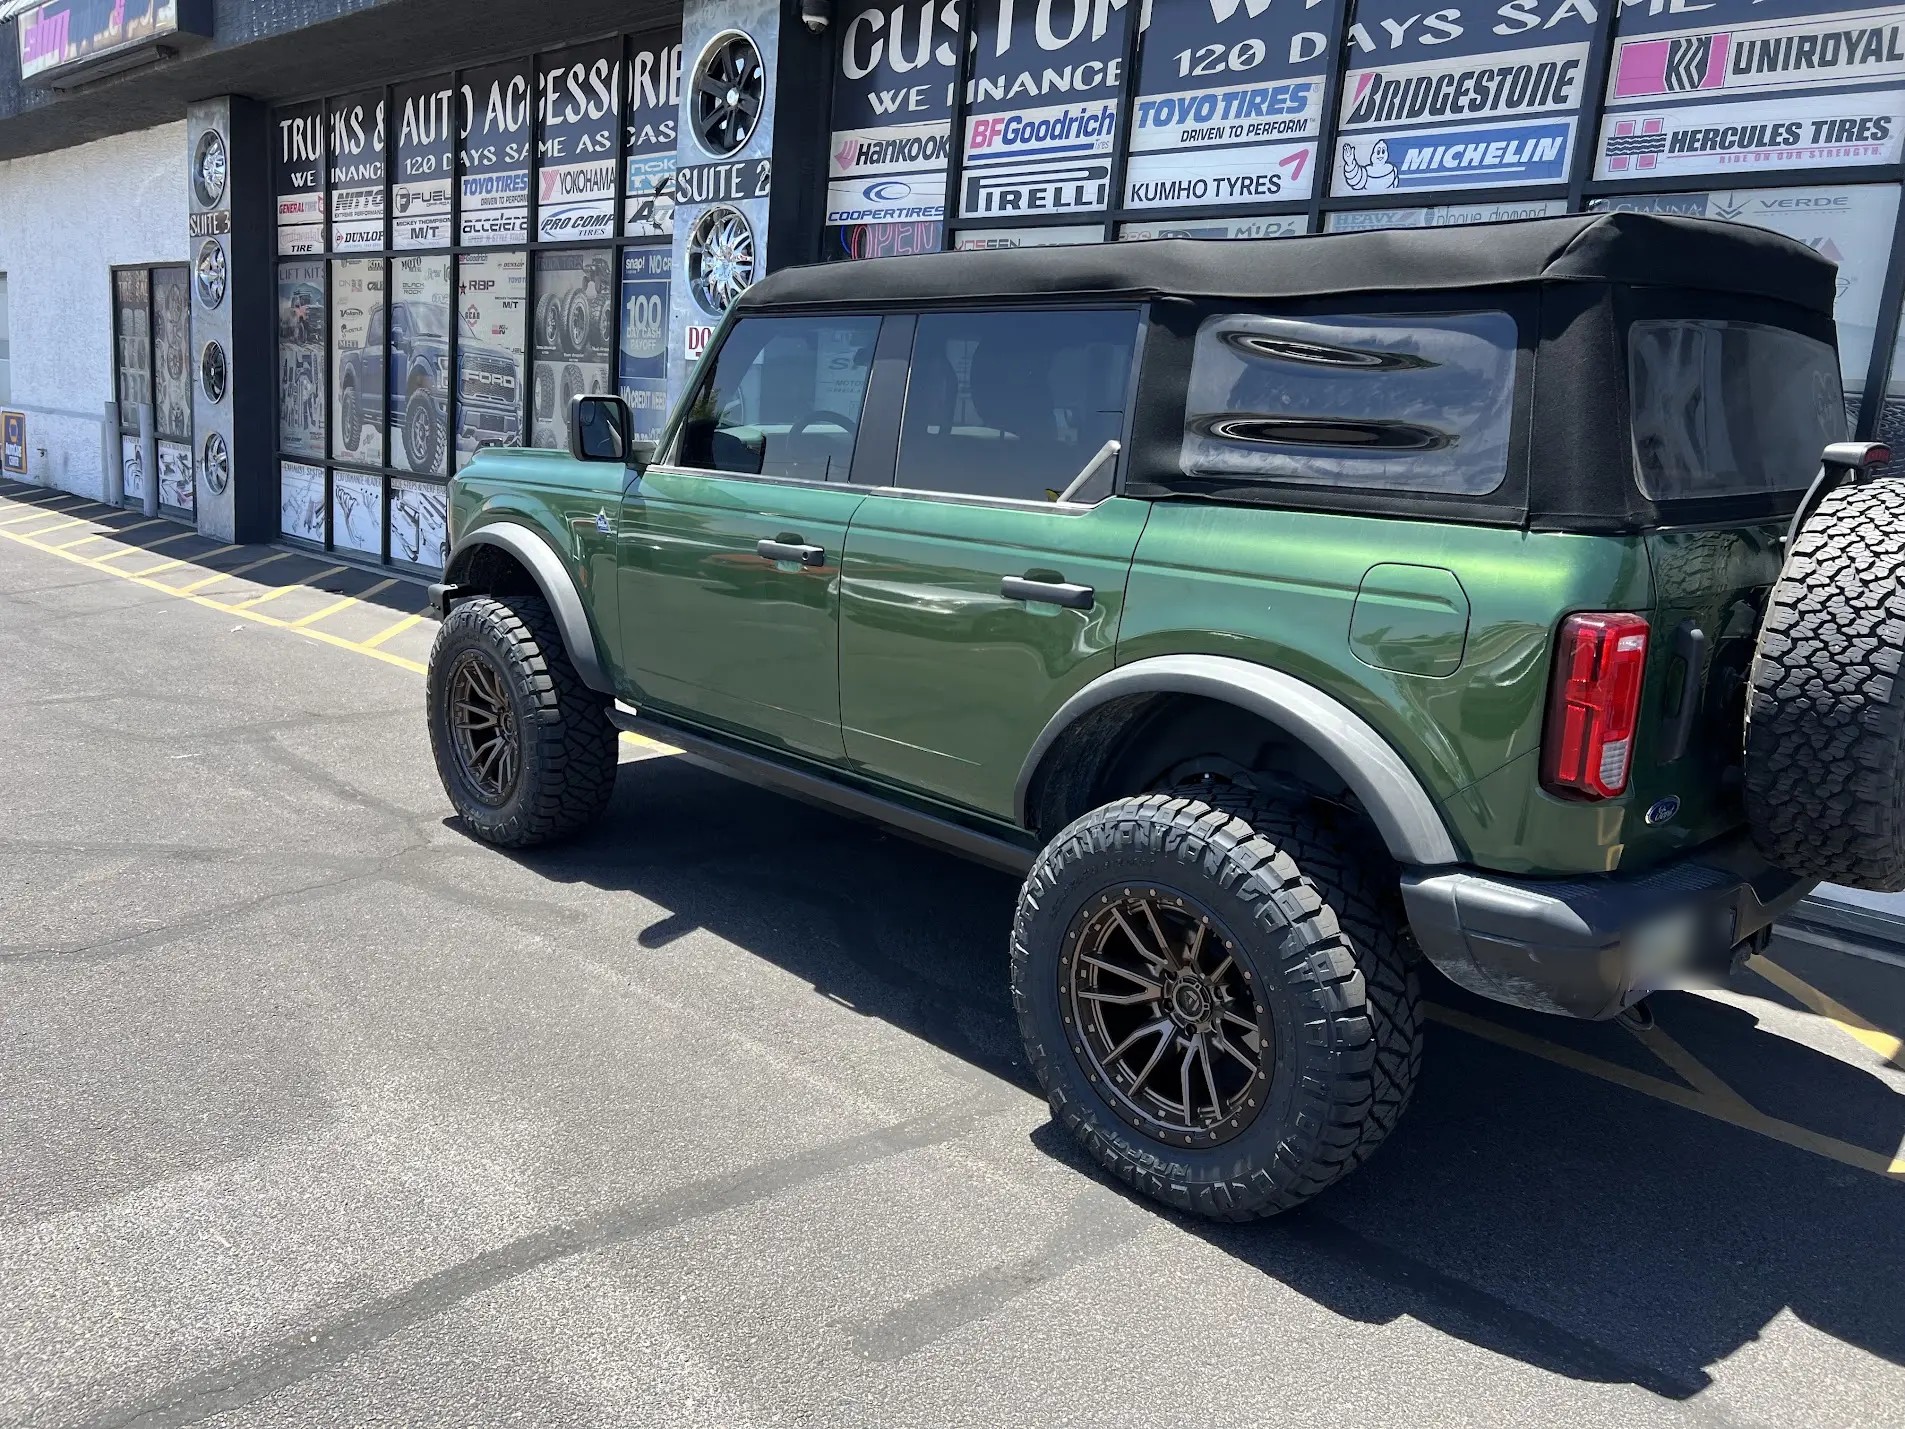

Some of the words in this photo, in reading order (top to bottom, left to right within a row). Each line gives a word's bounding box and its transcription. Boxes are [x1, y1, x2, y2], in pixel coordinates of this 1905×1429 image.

[1173, 38, 1266, 78] 120
[1289, 9, 1464, 64] DAYS
[1732, 26, 1904, 76] UNIROYAL
[867, 85, 931, 115] WE
[1346, 59, 1581, 125] BRIDGESTONE
[970, 105, 1115, 149] BFGoodrich
[1181, 126, 1225, 143] DRIVEN
[1228, 125, 1243, 138] TO
[1246, 119, 1308, 136] PERFORM
[1668, 122, 1803, 153] HERCULES
[1811, 116, 1892, 145] TIRES
[404, 155, 436, 175] 120
[575, 131, 611, 154] AS
[1401, 136, 1564, 171] MICHELIN
[1719, 154, 1748, 164] RIDE
[1754, 153, 1770, 162] ON
[1777, 152, 1802, 161] OUR
[290, 170, 317, 188] WE
[560, 167, 615, 195] YOKOHAMA
[676, 163, 746, 203] SUITE
[754, 159, 770, 197] 2
[965, 165, 1109, 213] PIRELLI
[1131, 178, 1208, 203] KUMHO
[1213, 174, 1282, 198] TYRES
[279, 202, 304, 214] GENERAL
[411, 190, 451, 203] FUEL
[1759, 196, 1849, 209] VERDE
[190, 212, 220, 237] SUITE
[223, 211, 231, 233] 3
[1338, 211, 1395, 226] HEAVY
[344, 231, 384, 243] DUNLOP
[410, 226, 440, 240] M/T
[578, 228, 606, 237] TIRES
[291, 245, 313, 253] TIRE
[279, 267, 301, 281] LIFT
[649, 255, 662, 274] NO
[469, 280, 495, 291] RBP
[626, 294, 662, 333] 100
